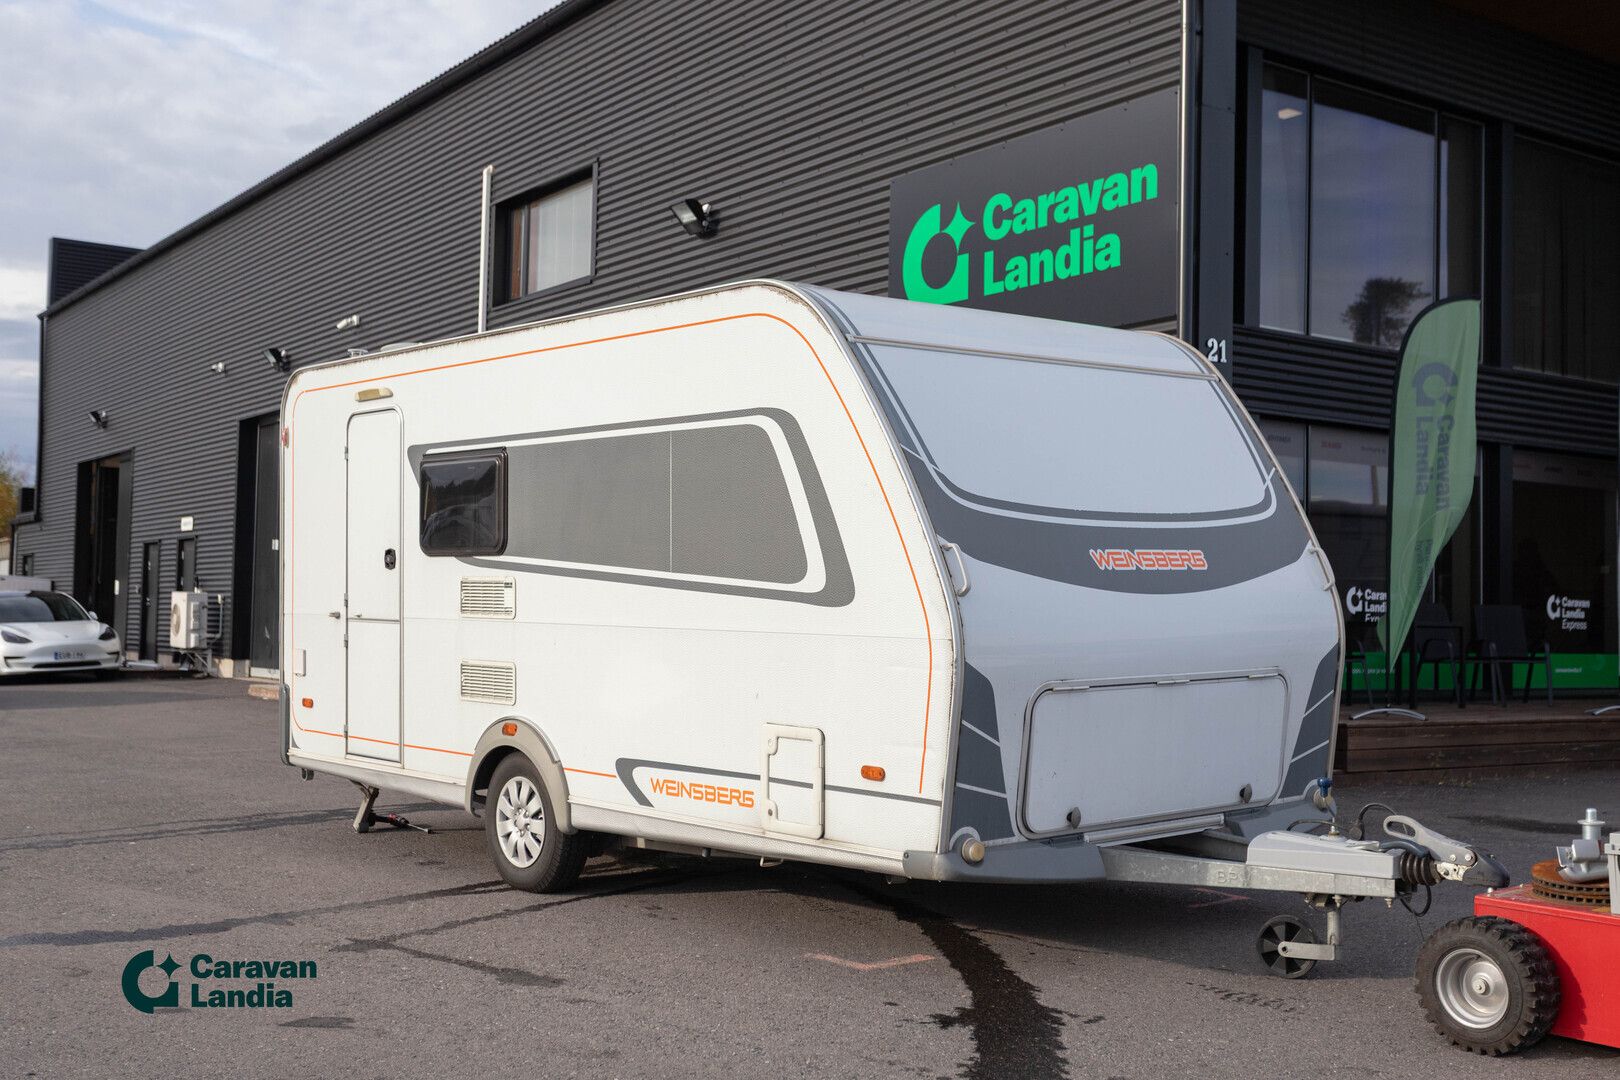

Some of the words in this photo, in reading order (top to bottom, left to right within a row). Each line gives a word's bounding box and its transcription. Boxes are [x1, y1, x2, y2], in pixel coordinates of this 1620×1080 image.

[983, 163, 1158, 241] Caravan
[984, 224, 1121, 296] Landia
[1207, 338, 1227, 363] 21
[1416, 416, 1434, 495] Landia
[1436, 415, 1455, 511] Caravan
[1089, 549, 1208, 570] WEINSBERG
[1561, 595, 1591, 609] Caravan
[650, 777, 755, 808] WEINSBERG
